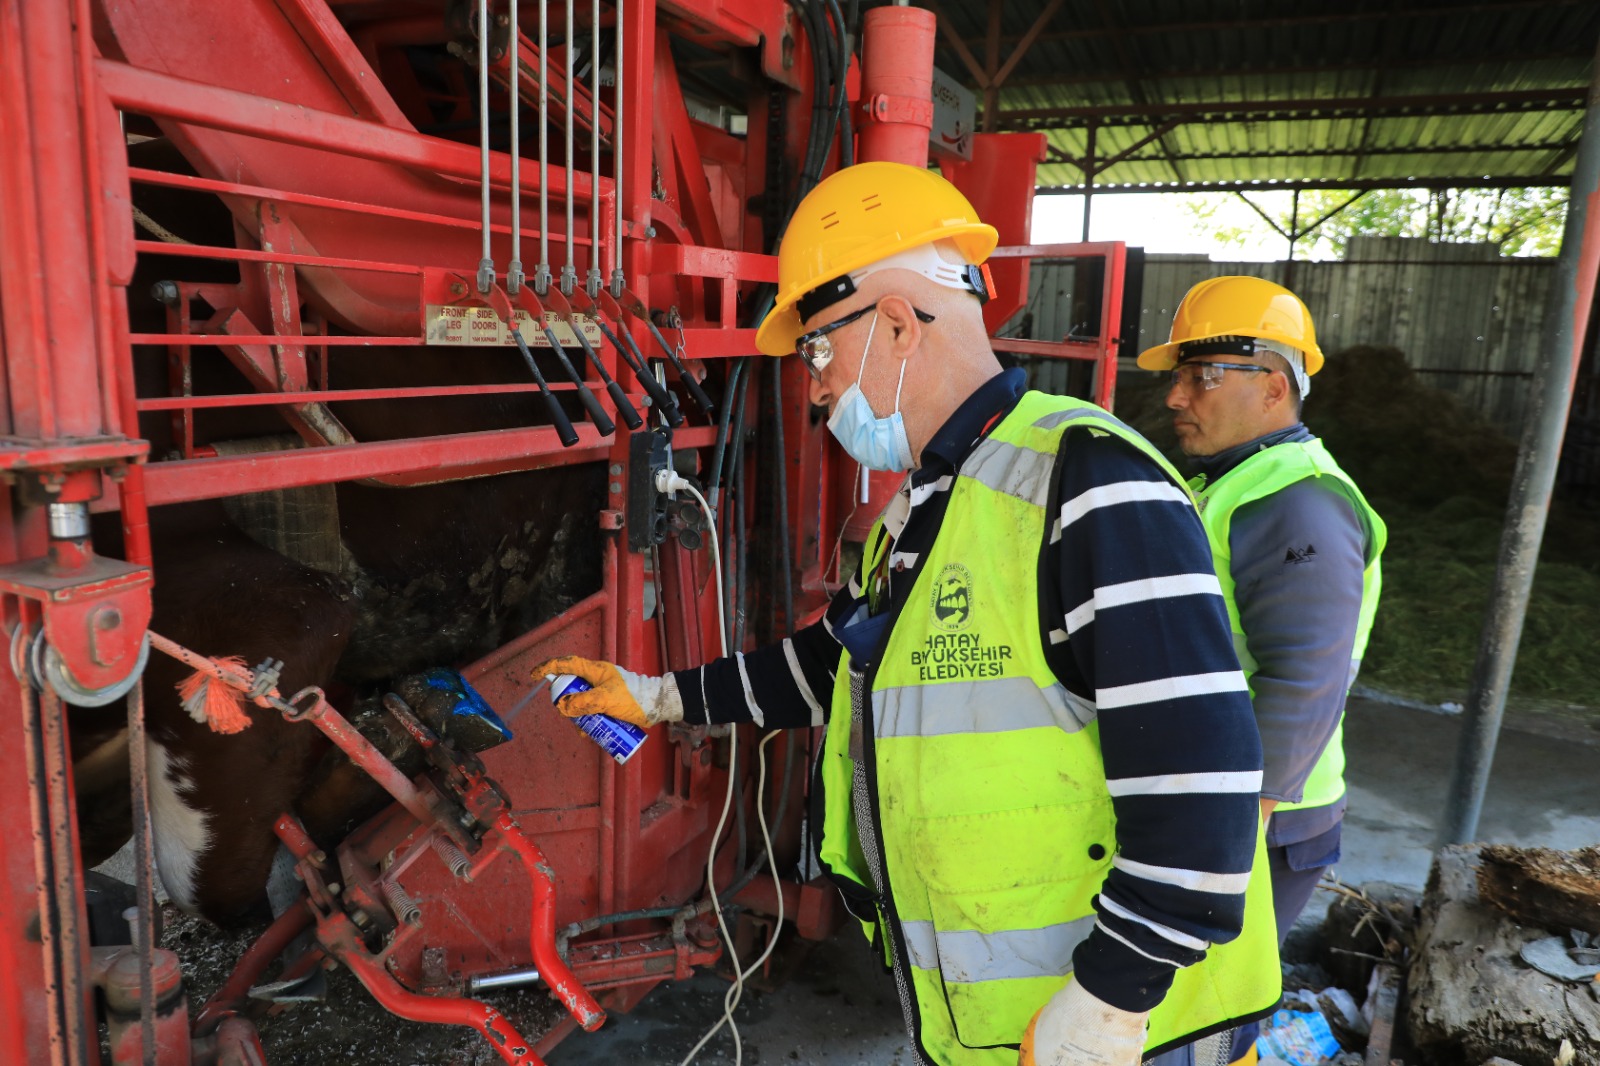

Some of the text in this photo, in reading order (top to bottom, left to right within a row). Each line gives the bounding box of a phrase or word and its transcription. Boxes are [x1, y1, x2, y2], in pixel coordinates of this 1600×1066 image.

[440, 307, 467, 318] FRONT
[476, 309, 493, 319] SIDE
[446, 320, 462, 330] LEG
[472, 321, 497, 330] DOORS
[925, 633, 980, 649] HATAY
[911, 645, 1012, 665] BYÜKŞEHİR
[920, 661, 1004, 680] ELEDİYESİ
